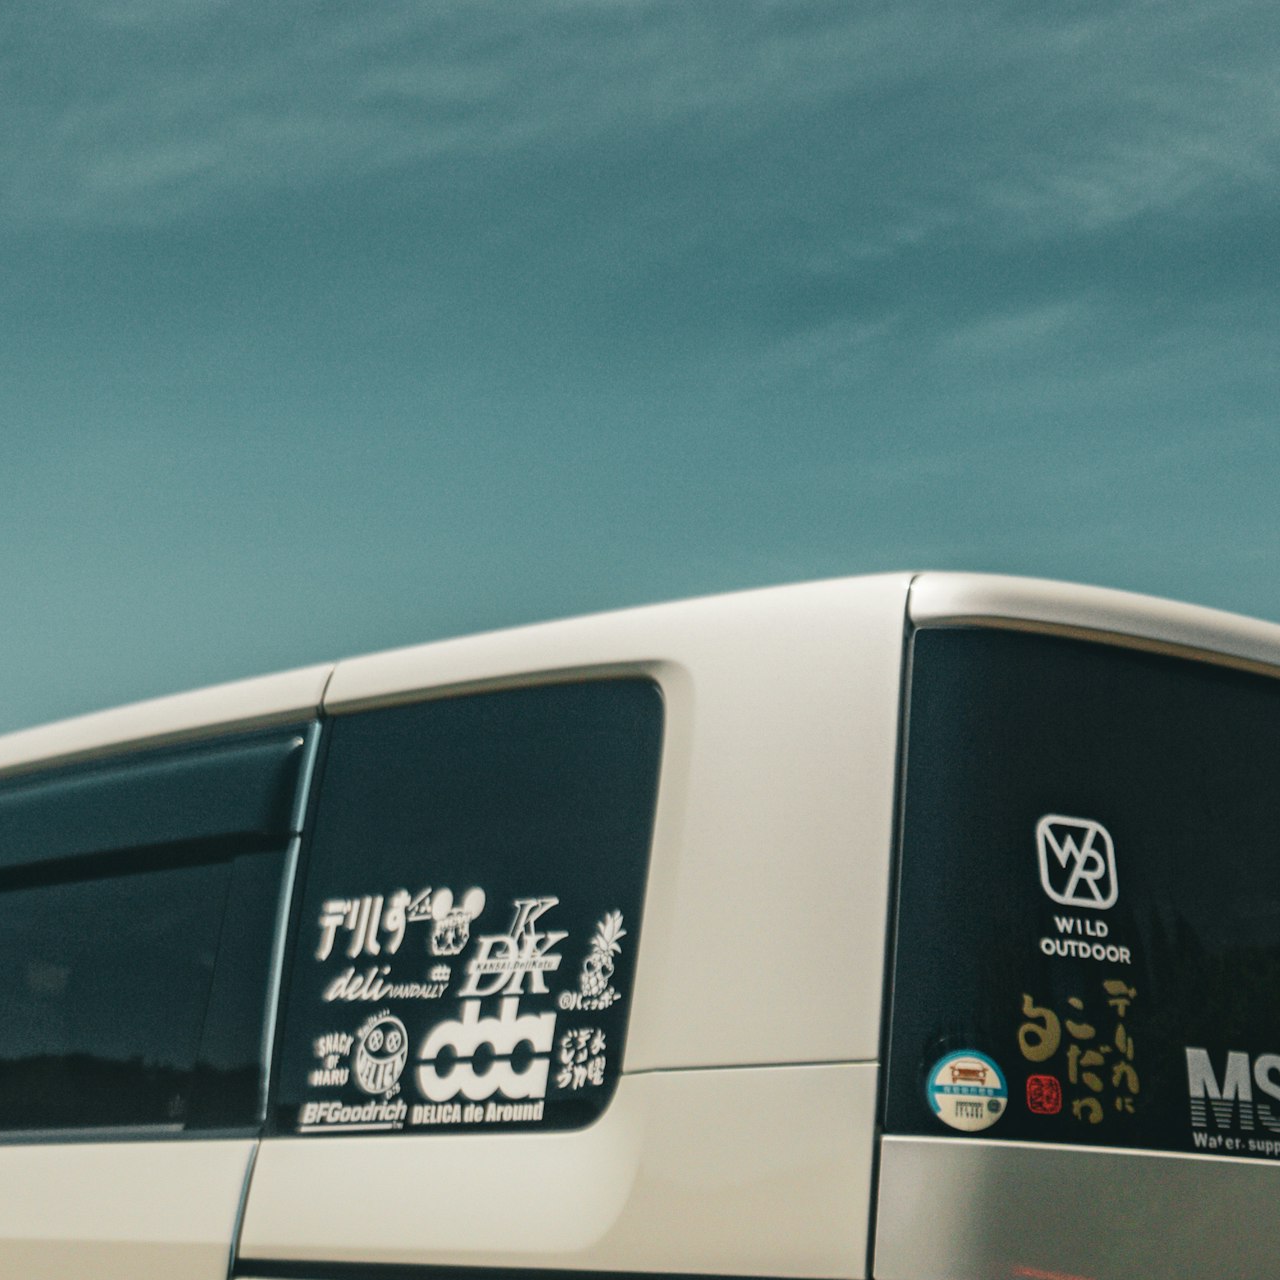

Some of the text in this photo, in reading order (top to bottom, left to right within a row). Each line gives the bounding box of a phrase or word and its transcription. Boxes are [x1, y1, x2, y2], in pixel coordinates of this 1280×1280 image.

[1055, 916, 1108, 937] WILD
[1040, 938, 1131, 964] OUTDOOR
[316, 1032, 354, 1057] SNACK
[302, 1099, 408, 1124] BFGoodrich
[411, 1101, 544, 1125] DELICA de Around
